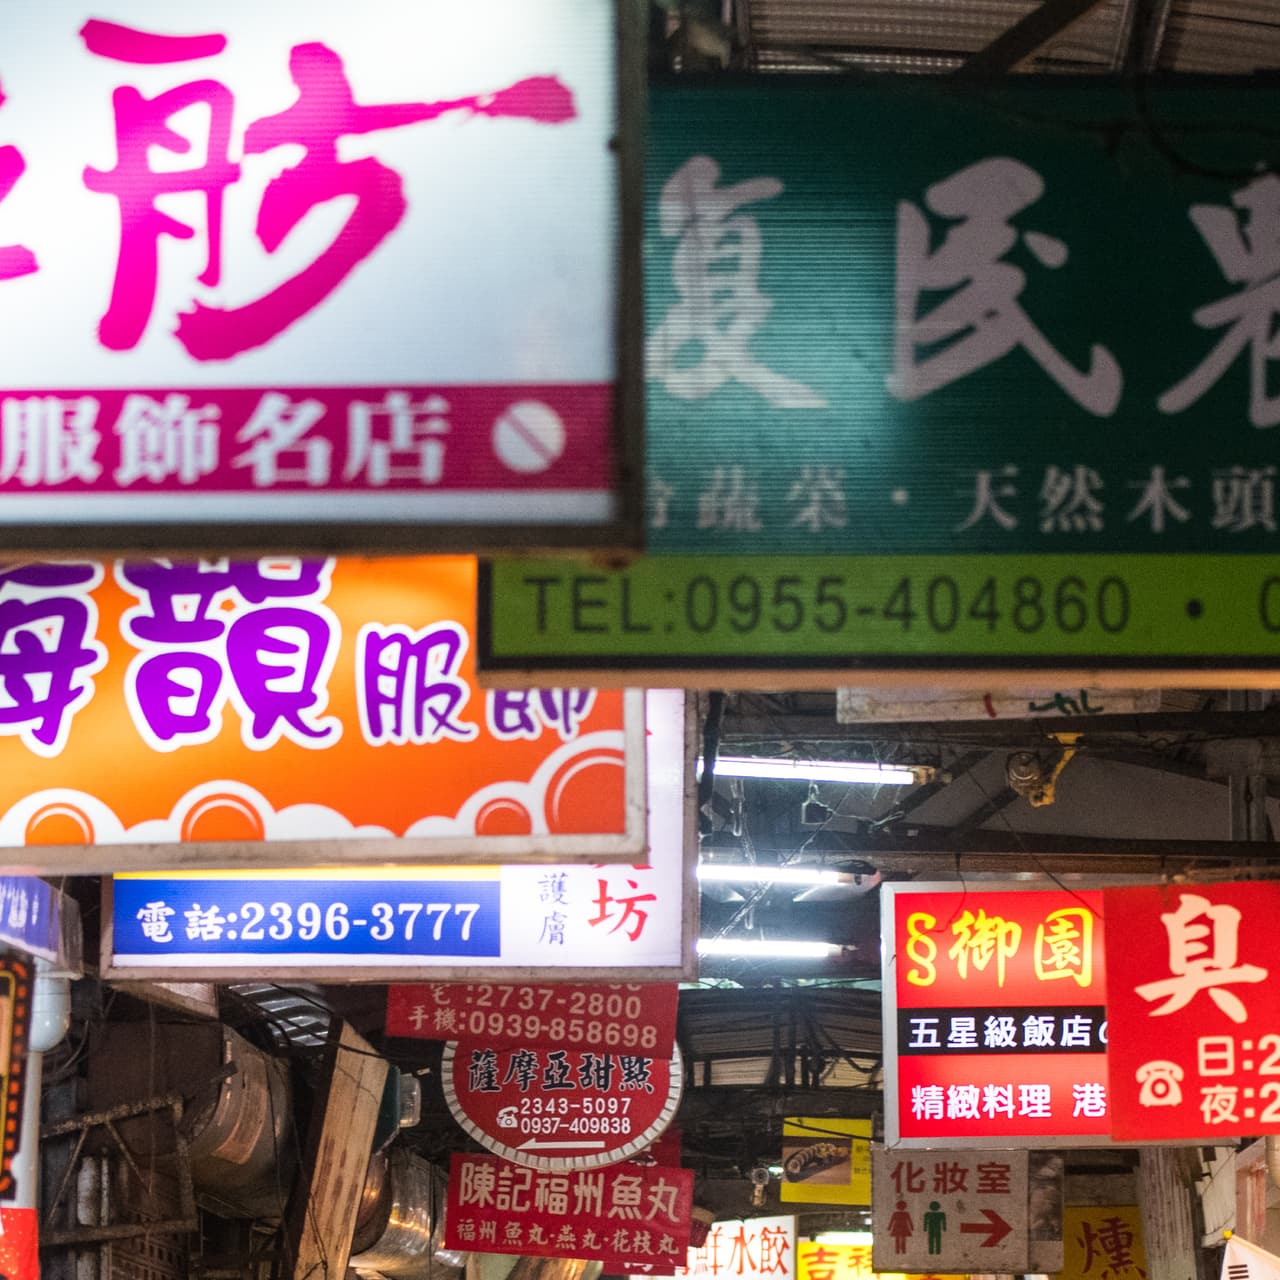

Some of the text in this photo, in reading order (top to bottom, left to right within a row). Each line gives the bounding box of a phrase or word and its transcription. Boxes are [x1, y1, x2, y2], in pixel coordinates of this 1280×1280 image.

[531, 574, 1132, 635] TEL:0955-404860
[588, 864, 657, 942] 坊
[521, 1097, 632, 1115] 2343-5097
[911, 1084, 1052, 1120] 精緻料理
[521, 1117, 631, 1134] 0937-409838
[459, 1162, 681, 1223] 陳記福州魚丸
[890, 1161, 1011, 1195] 化妝室
[675, 1225, 790, 1276] 鮮水餃
